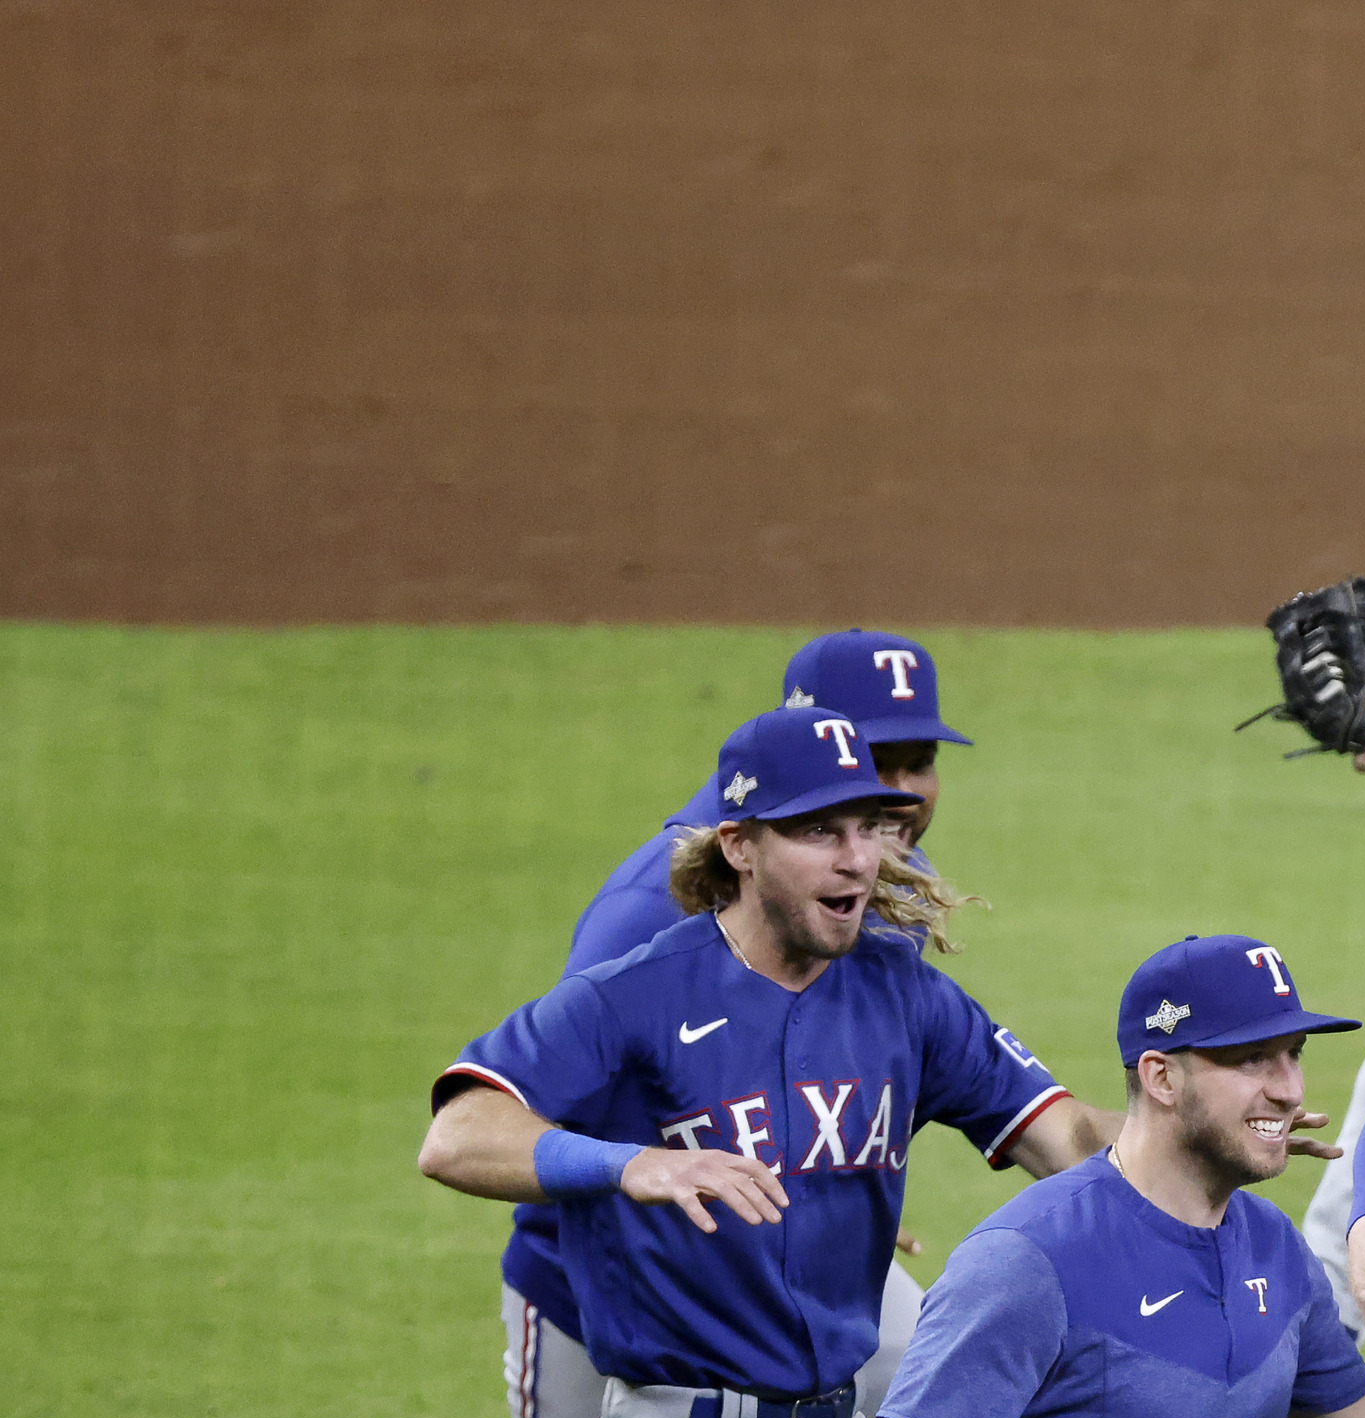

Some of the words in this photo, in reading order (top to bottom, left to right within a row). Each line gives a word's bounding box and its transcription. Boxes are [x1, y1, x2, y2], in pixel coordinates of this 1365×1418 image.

[873, 650, 919, 700] T
[812, 719, 860, 769] T
[1246, 946, 1291, 997] T
[1244, 1277, 1268, 1315] T
